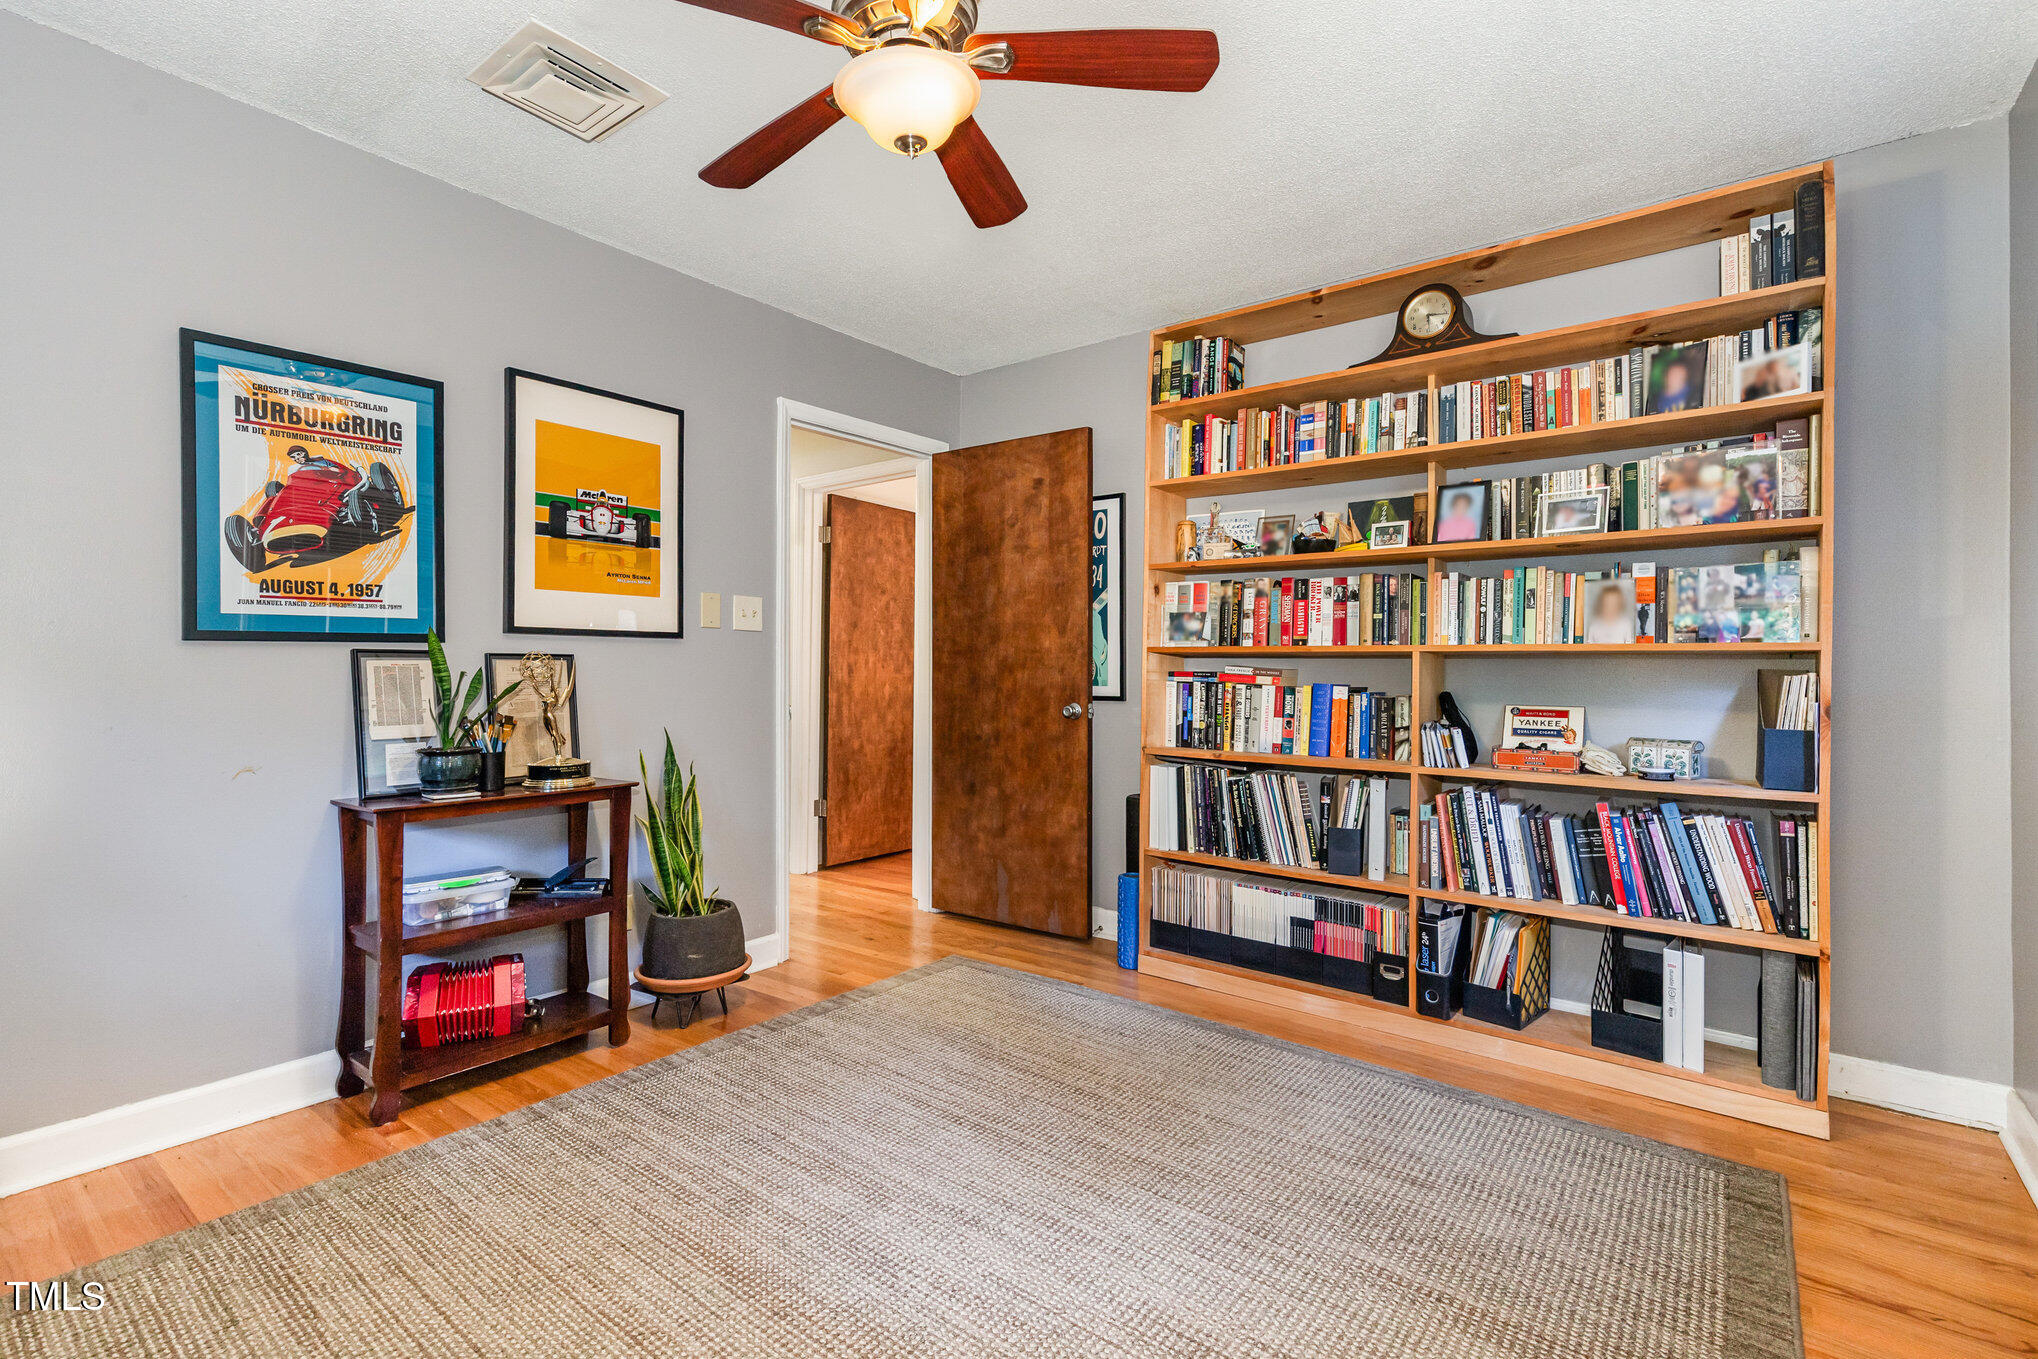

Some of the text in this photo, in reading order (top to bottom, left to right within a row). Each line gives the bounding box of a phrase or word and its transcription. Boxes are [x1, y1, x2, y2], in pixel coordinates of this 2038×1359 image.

[252, 383, 388, 413] GROSSER PREIS VON DEUTSCHLAND
[234, 391, 403, 445] NÜRBURGRING
[1396, 418, 1405, 443] DANTE
[235, 424, 403, 455] UM DIE AUTOMOBIL WELTMEISTERSCHAFT
[580, 490, 624, 504] McLren
[256, 599, 283, 607] MANUEL
[259, 578, 325, 596] AUGUST
[347, 583, 383, 599] 1957
[1258, 600, 1267, 636] GRANT
[1284, 595, 1292, 623] SHERMAN
[1297, 601, 1305, 635] WASHINGTON
[1285, 695, 1293, 715] MONK
[1380, 712, 1388, 738] MOZART
[1519, 719, 1562, 728] YANKEE
[1465, 790, 1479, 843] CUT & DRIED
[1307, 822, 1317, 858] guitarmaking
[1530, 819, 1542, 863] PRINCIPLES DESIGN
[1602, 811, 1622, 880] BLACK MOUNTAIN COLLEGE
[1614, 827, 1627, 863] Alvar Aalto
[1431, 851, 1439, 877] AMERICA
[1689, 829, 1717, 890] UNDERSTANDING WOOD
[1745, 854, 1754, 869] WOOD
[1420, 945, 1430, 967] laser
